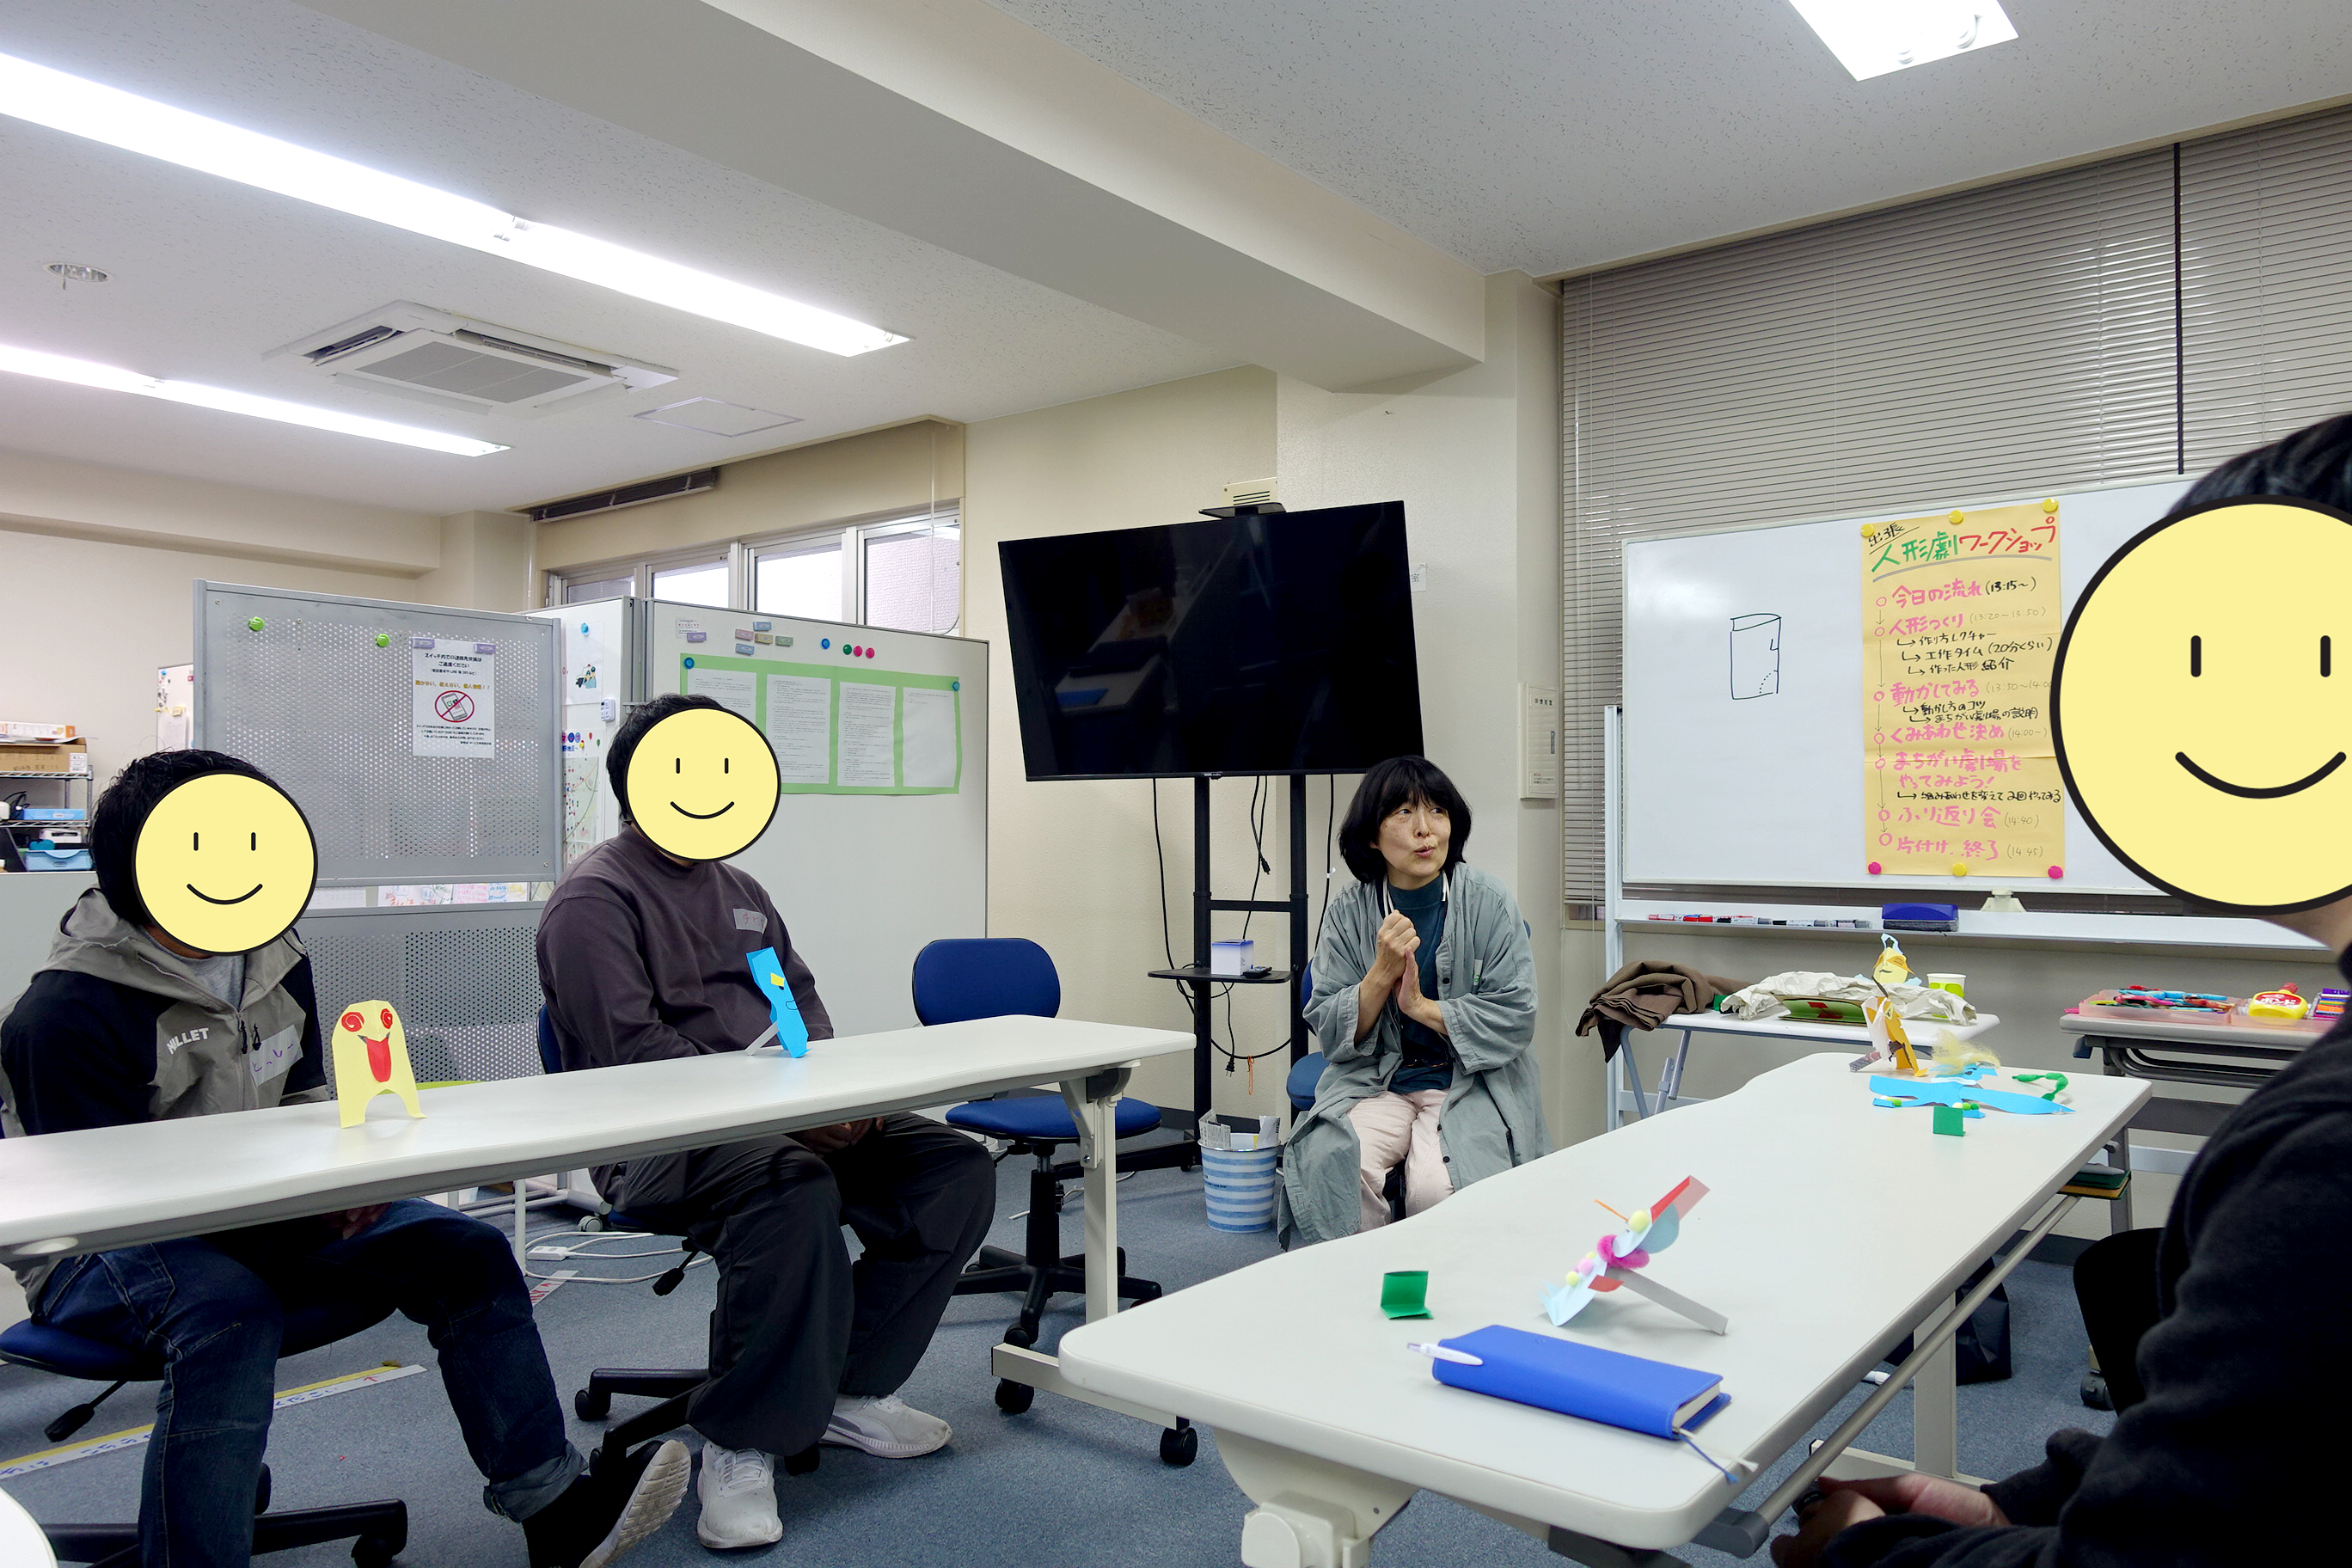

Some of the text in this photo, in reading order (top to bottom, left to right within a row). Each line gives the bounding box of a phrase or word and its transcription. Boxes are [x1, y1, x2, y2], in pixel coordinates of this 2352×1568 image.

[1869, 522, 1904, 548] 出張
[1871, 516, 2056, 573] 人形劇ワークショップ
[1891, 578, 1982, 609] 今日の流れ
[1889, 613, 1963, 636] 人形つくり
[1890, 678, 1980, 707] 動かしてみる
[1890, 721, 2005, 744] くみあわせ決め
[1893, 748, 2022, 773] まちがい劇場を
[1897, 805, 2001, 829] ふり返り会
